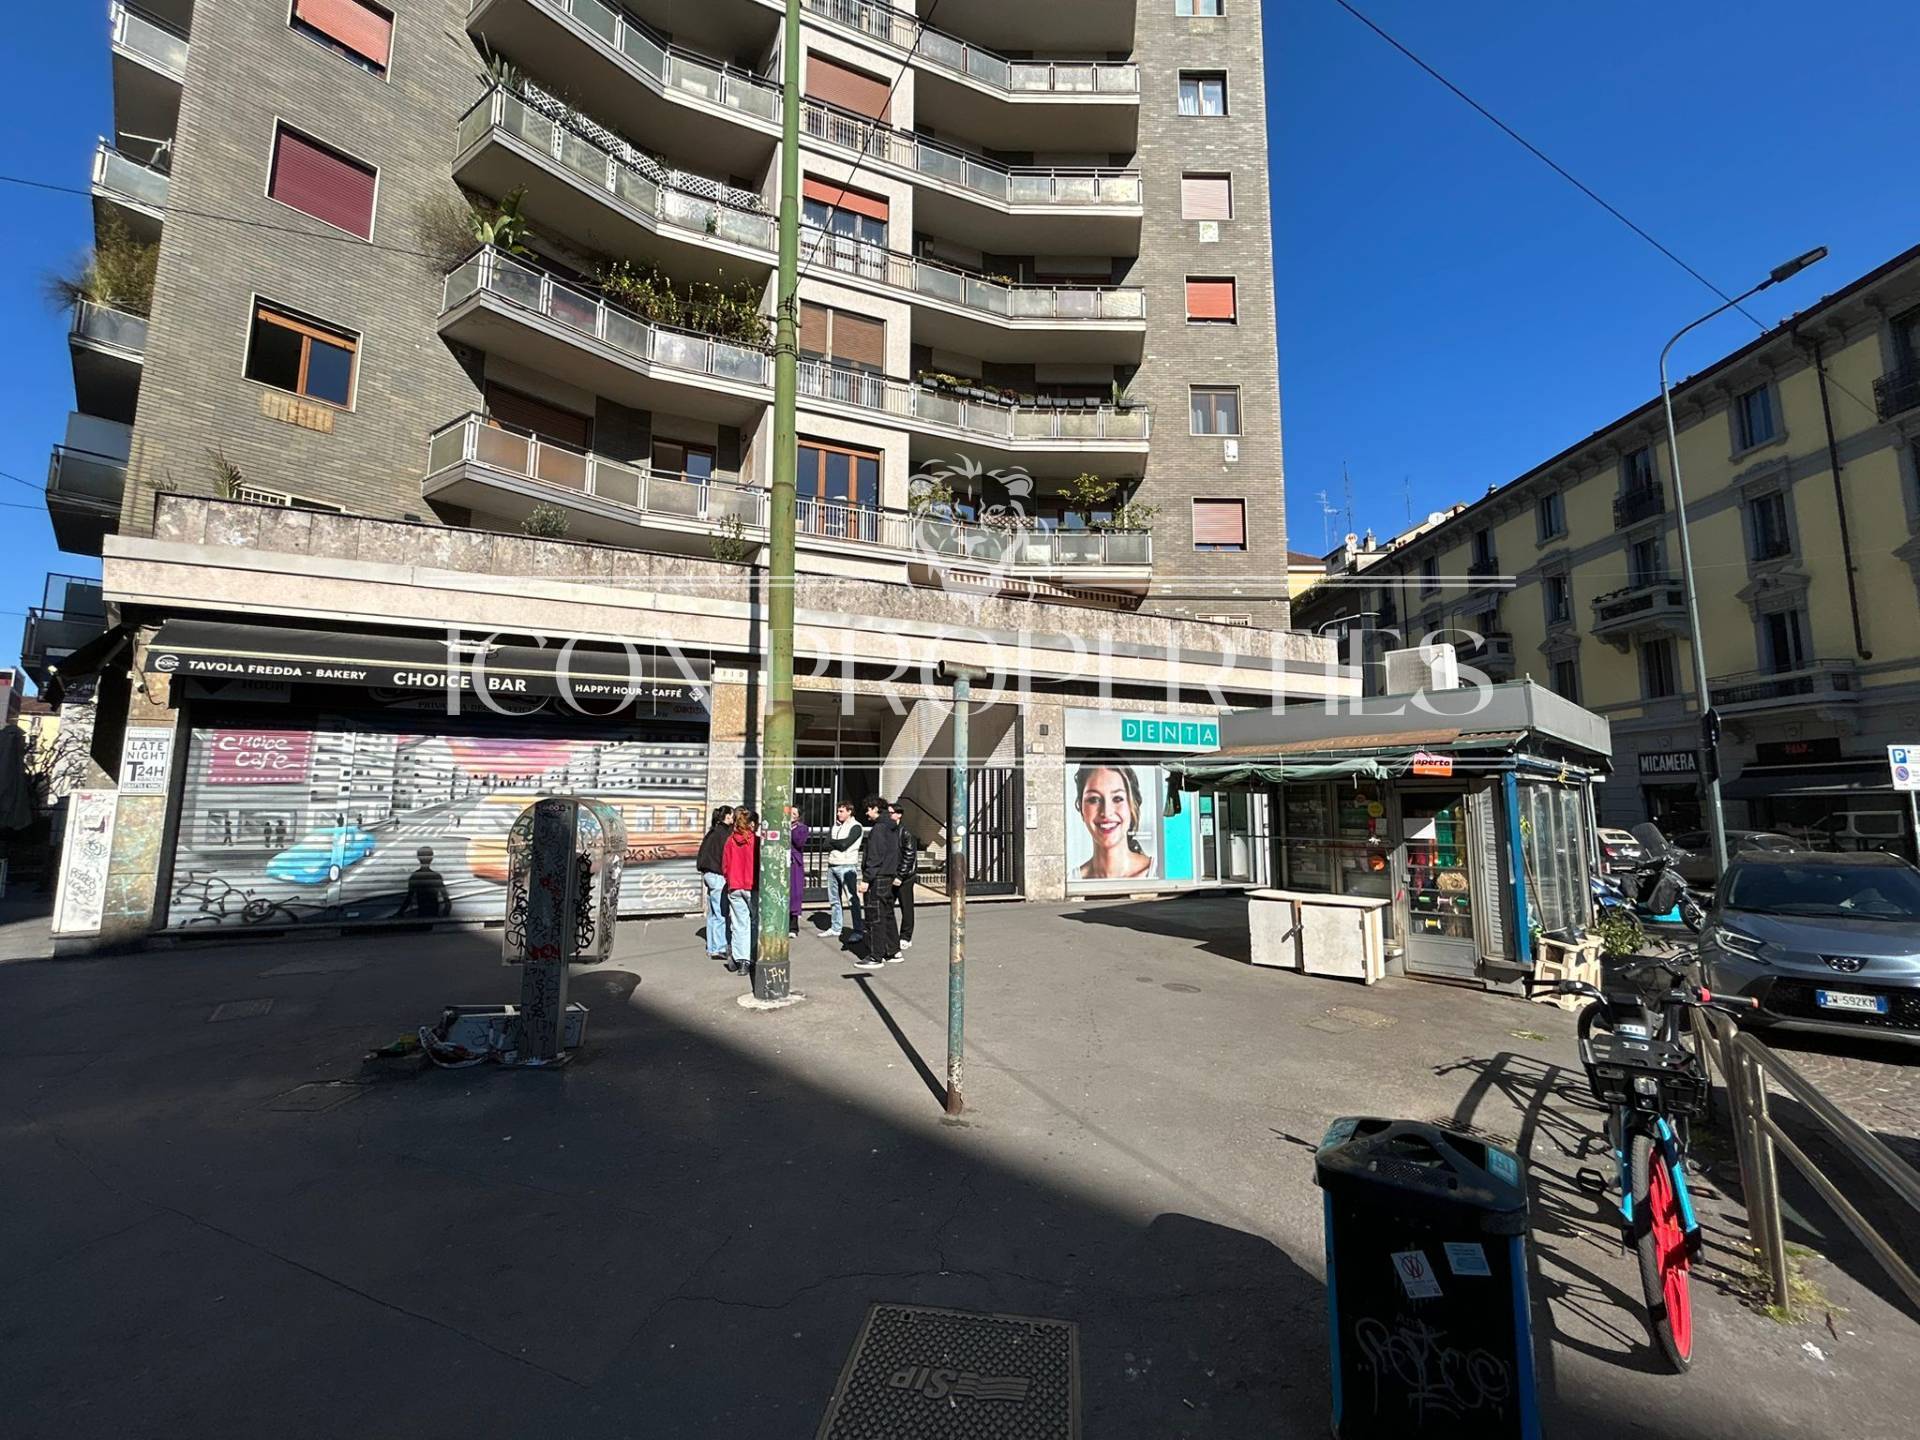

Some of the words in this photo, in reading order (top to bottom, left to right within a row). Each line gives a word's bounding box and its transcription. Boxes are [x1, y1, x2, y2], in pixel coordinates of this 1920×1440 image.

[188, 660, 245, 673] TAVOLA
[248, 664, 303, 677] FREDDA
[315, 668, 367, 680] BAKERY
[393, 671, 471, 689] CHOICE
[488, 677, 527, 692] BAR
[575, 684, 611, 694] HAPPY
[612, 686, 643, 696] HOUR
[1125, 722, 1215, 743] DENTA
[132, 741, 164, 751] LATE
[127, 751, 165, 760] NIGHT
[1415, 759, 1451, 767] aperto
[1640, 752, 1696, 772] MICAMERA
